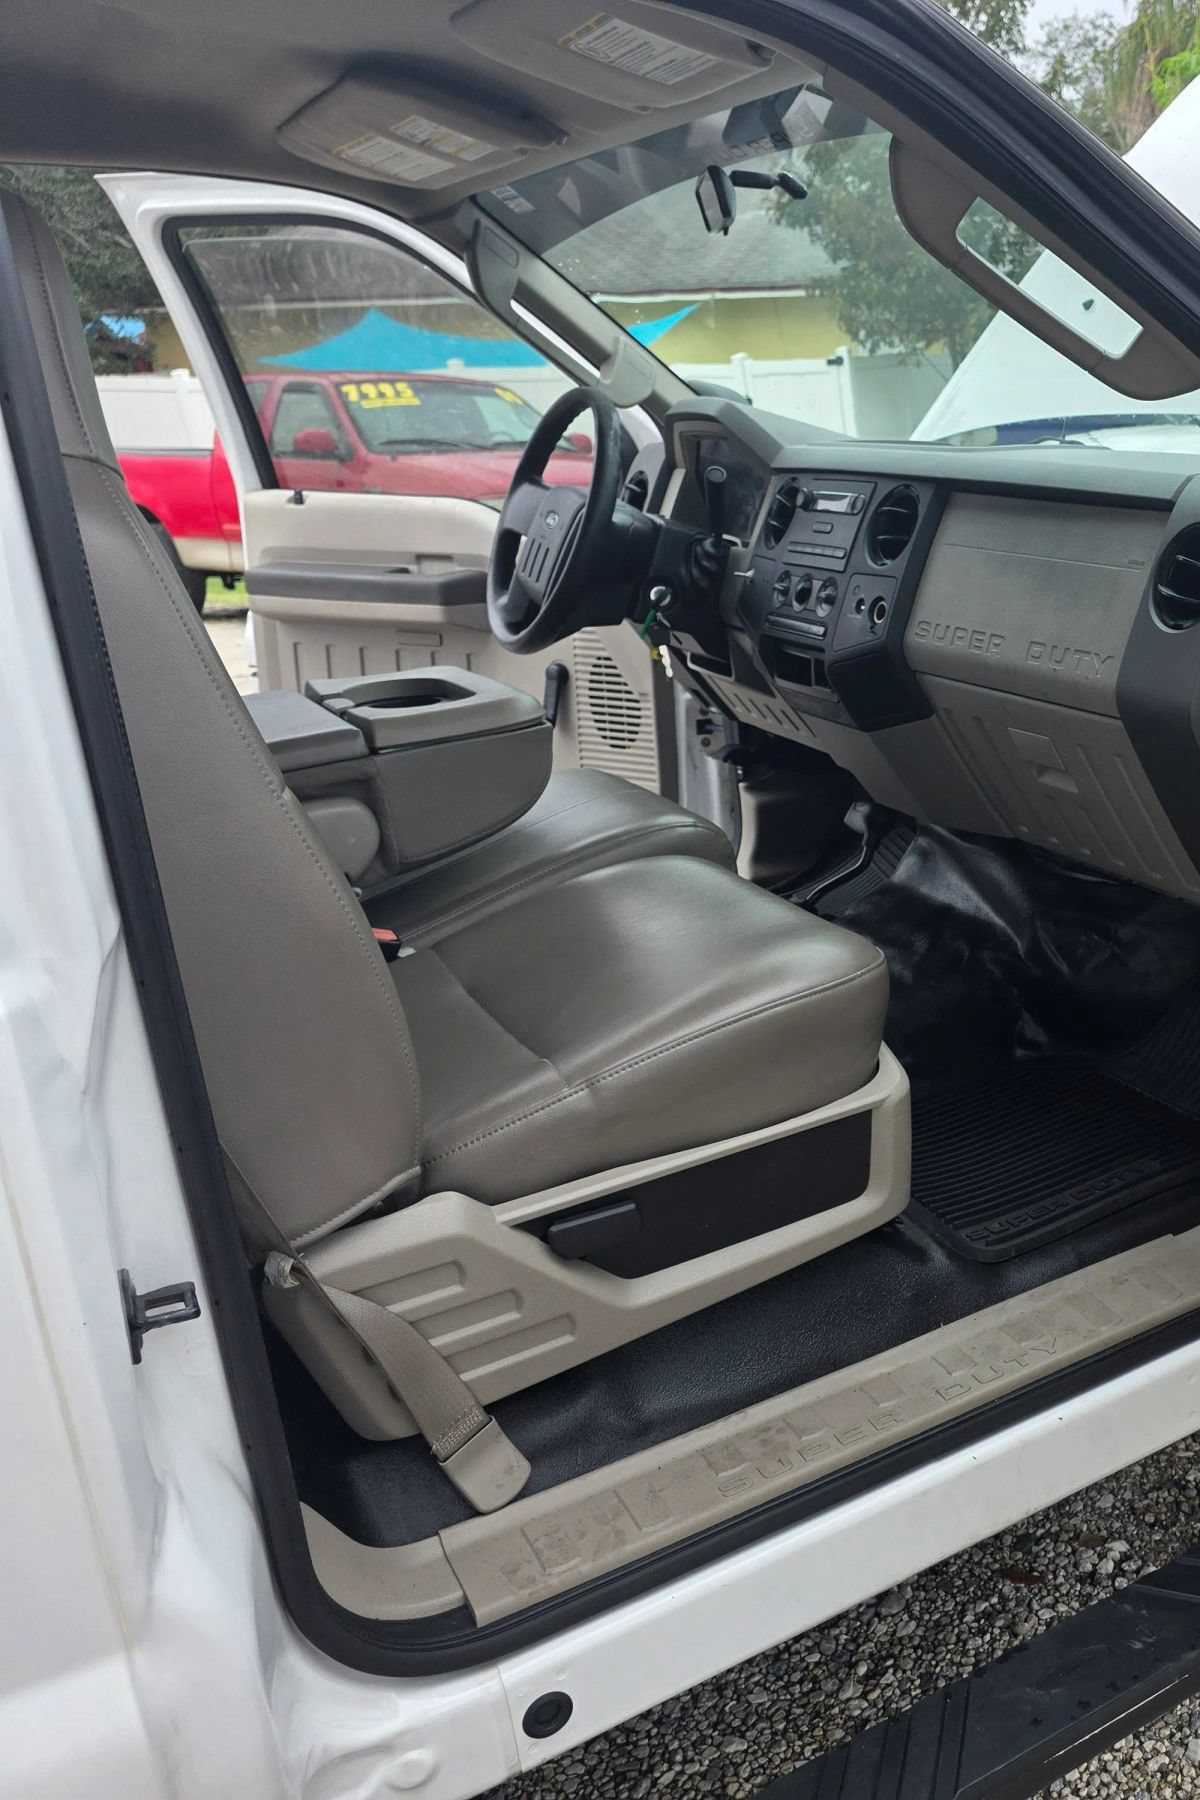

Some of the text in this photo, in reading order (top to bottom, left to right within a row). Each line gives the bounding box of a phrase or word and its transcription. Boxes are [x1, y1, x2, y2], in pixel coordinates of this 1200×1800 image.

[913, 619, 1115, 678] SUPER DUTY
[963, 1200, 1069, 1242] SUPER
[717, 1337, 1057, 1498] SUPER DUTY
